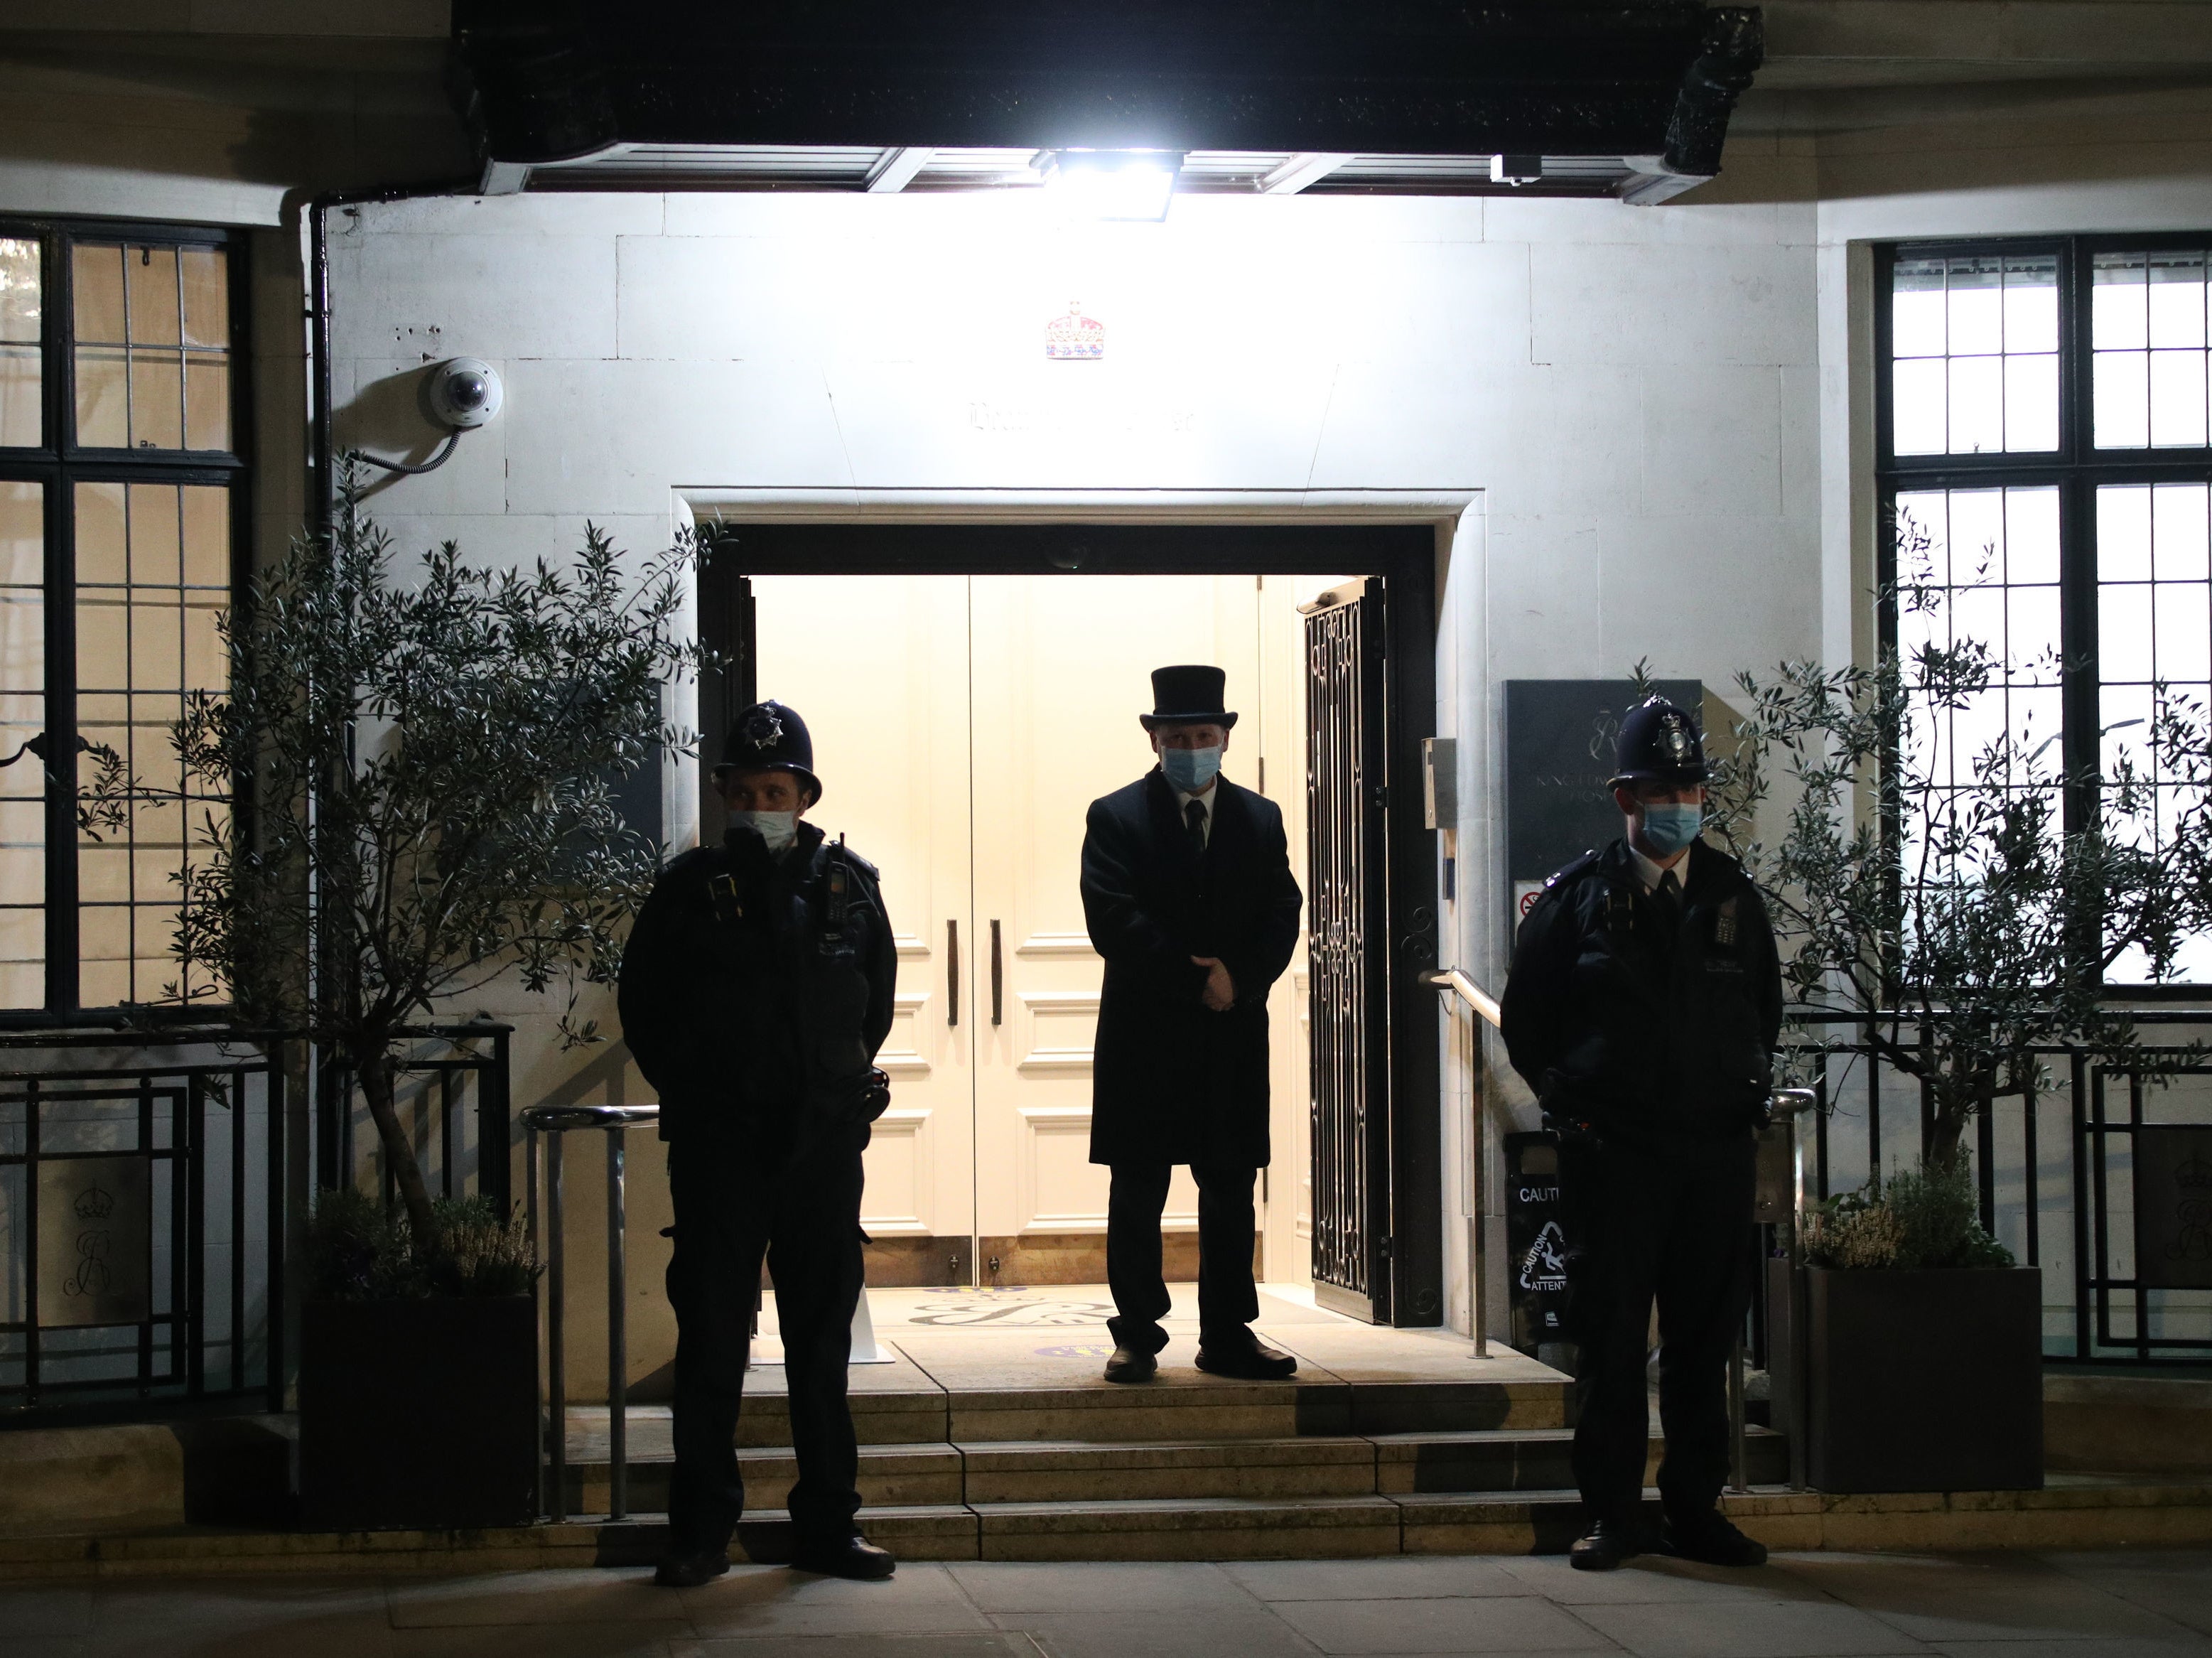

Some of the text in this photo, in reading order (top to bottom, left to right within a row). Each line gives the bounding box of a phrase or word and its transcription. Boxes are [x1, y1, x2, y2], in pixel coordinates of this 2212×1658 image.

[1520, 1187, 1559, 1202] CAUTI
[1522, 1234, 1548, 1274] CAUTION
[1531, 1281, 1565, 1291] ATTENT
